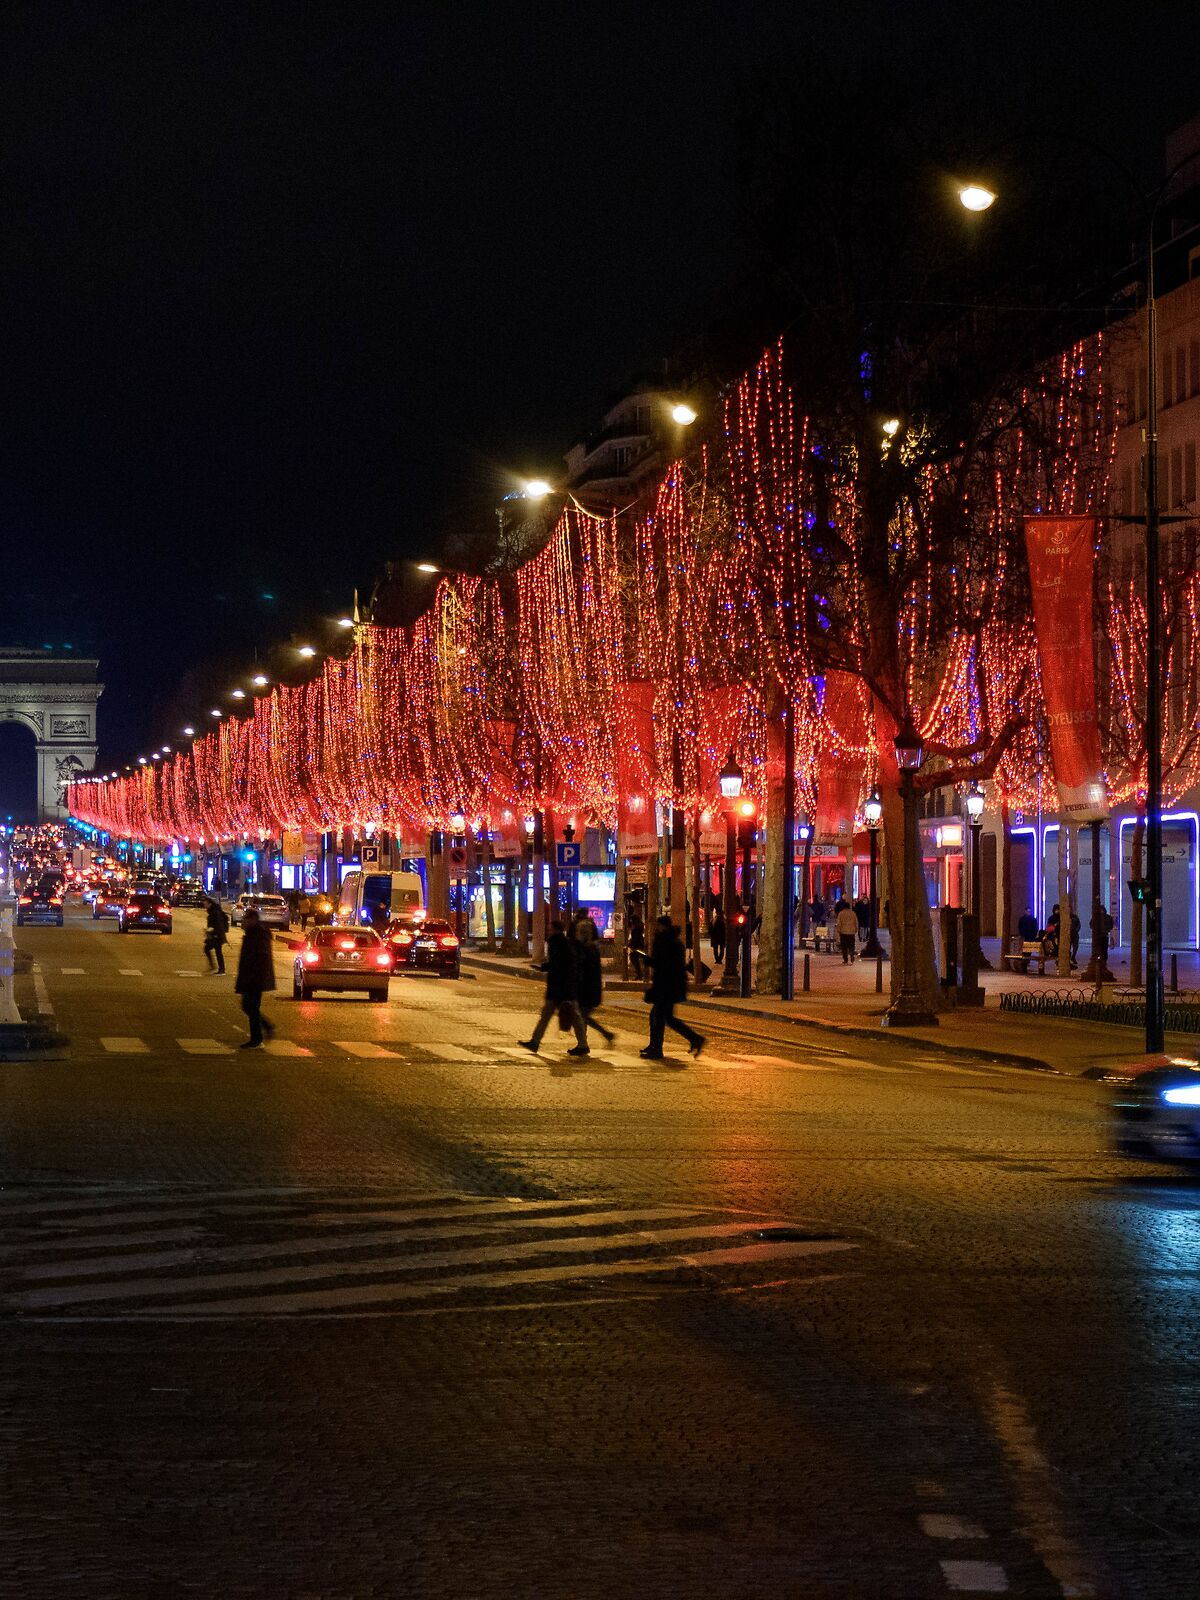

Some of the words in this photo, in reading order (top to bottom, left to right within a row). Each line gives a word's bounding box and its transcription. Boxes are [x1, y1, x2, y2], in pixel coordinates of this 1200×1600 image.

[1045, 546, 1070, 555] PARIS
[1047, 710, 1094, 726] OYEUSES
[366, 849, 374, 860] P
[563, 846, 575, 862] P
